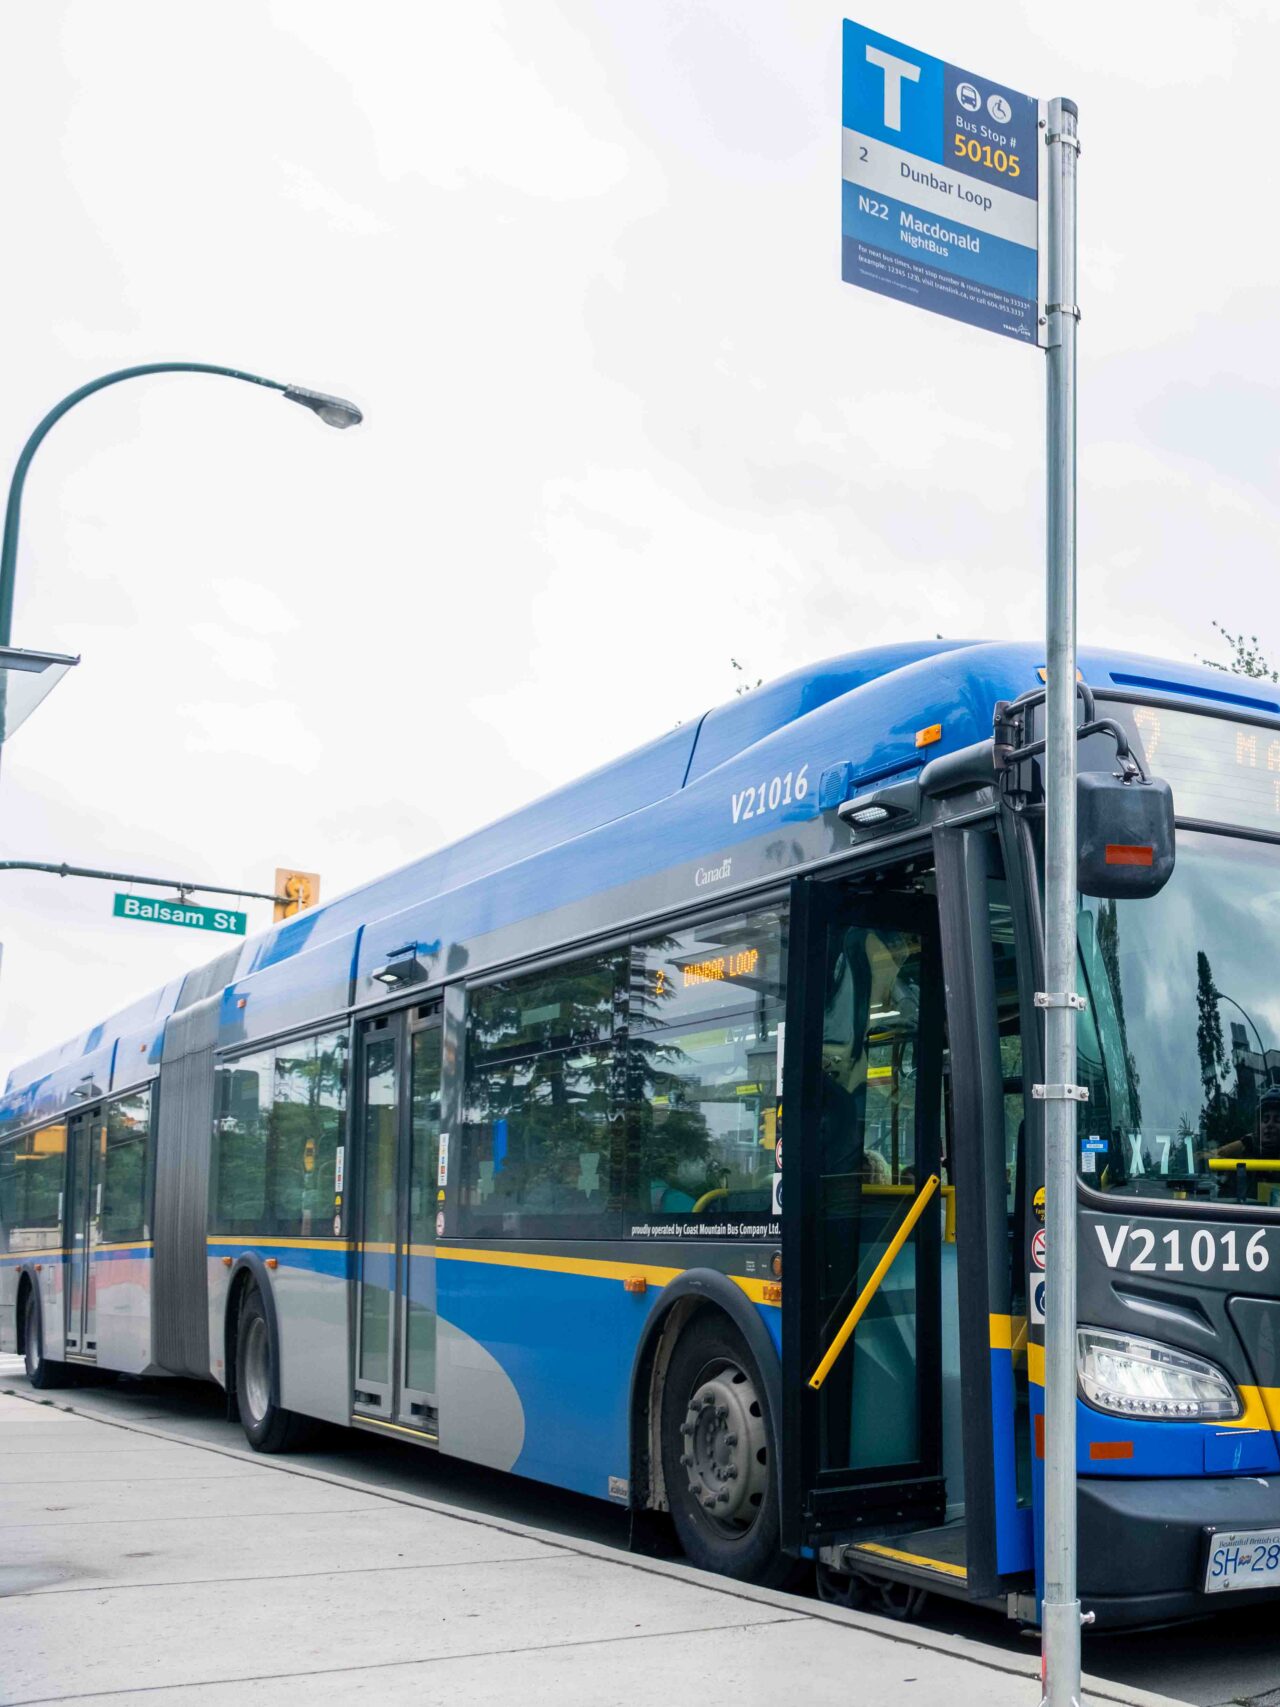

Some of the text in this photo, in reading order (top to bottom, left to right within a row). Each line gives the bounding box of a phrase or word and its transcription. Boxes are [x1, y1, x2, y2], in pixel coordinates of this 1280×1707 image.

[866, 44, 921, 132] T
[956, 115, 1017, 148] Bus Stop #
[954, 133, 1021, 177] 50105
[859, 146, 993, 211] 2 Dunbar Loop
[858, 195, 980, 254] N22 Macdonald
[900, 230, 949, 257] NightBus
[883, 253, 893, 263] bus
[939, 275, 960, 286] number
[966, 284, 980, 293] route
[981, 289, 1003, 300] number
[731, 763, 809, 824] V21016
[695, 860, 731, 887] Canada
[124, 898, 237, 931] Balsam St
[656, 948, 758, 995] 2 DUNBAR LOOP
[631, 1222, 781, 1237] proudly operated by Coast Mountain Bus Company Ltd.
[1094, 1225, 1270, 1272] V21016
[1212, 1547, 1240, 1576] SH
[1219, 1538, 1248, 1548] Beautiful
[1249, 1536, 1272, 1545] British
